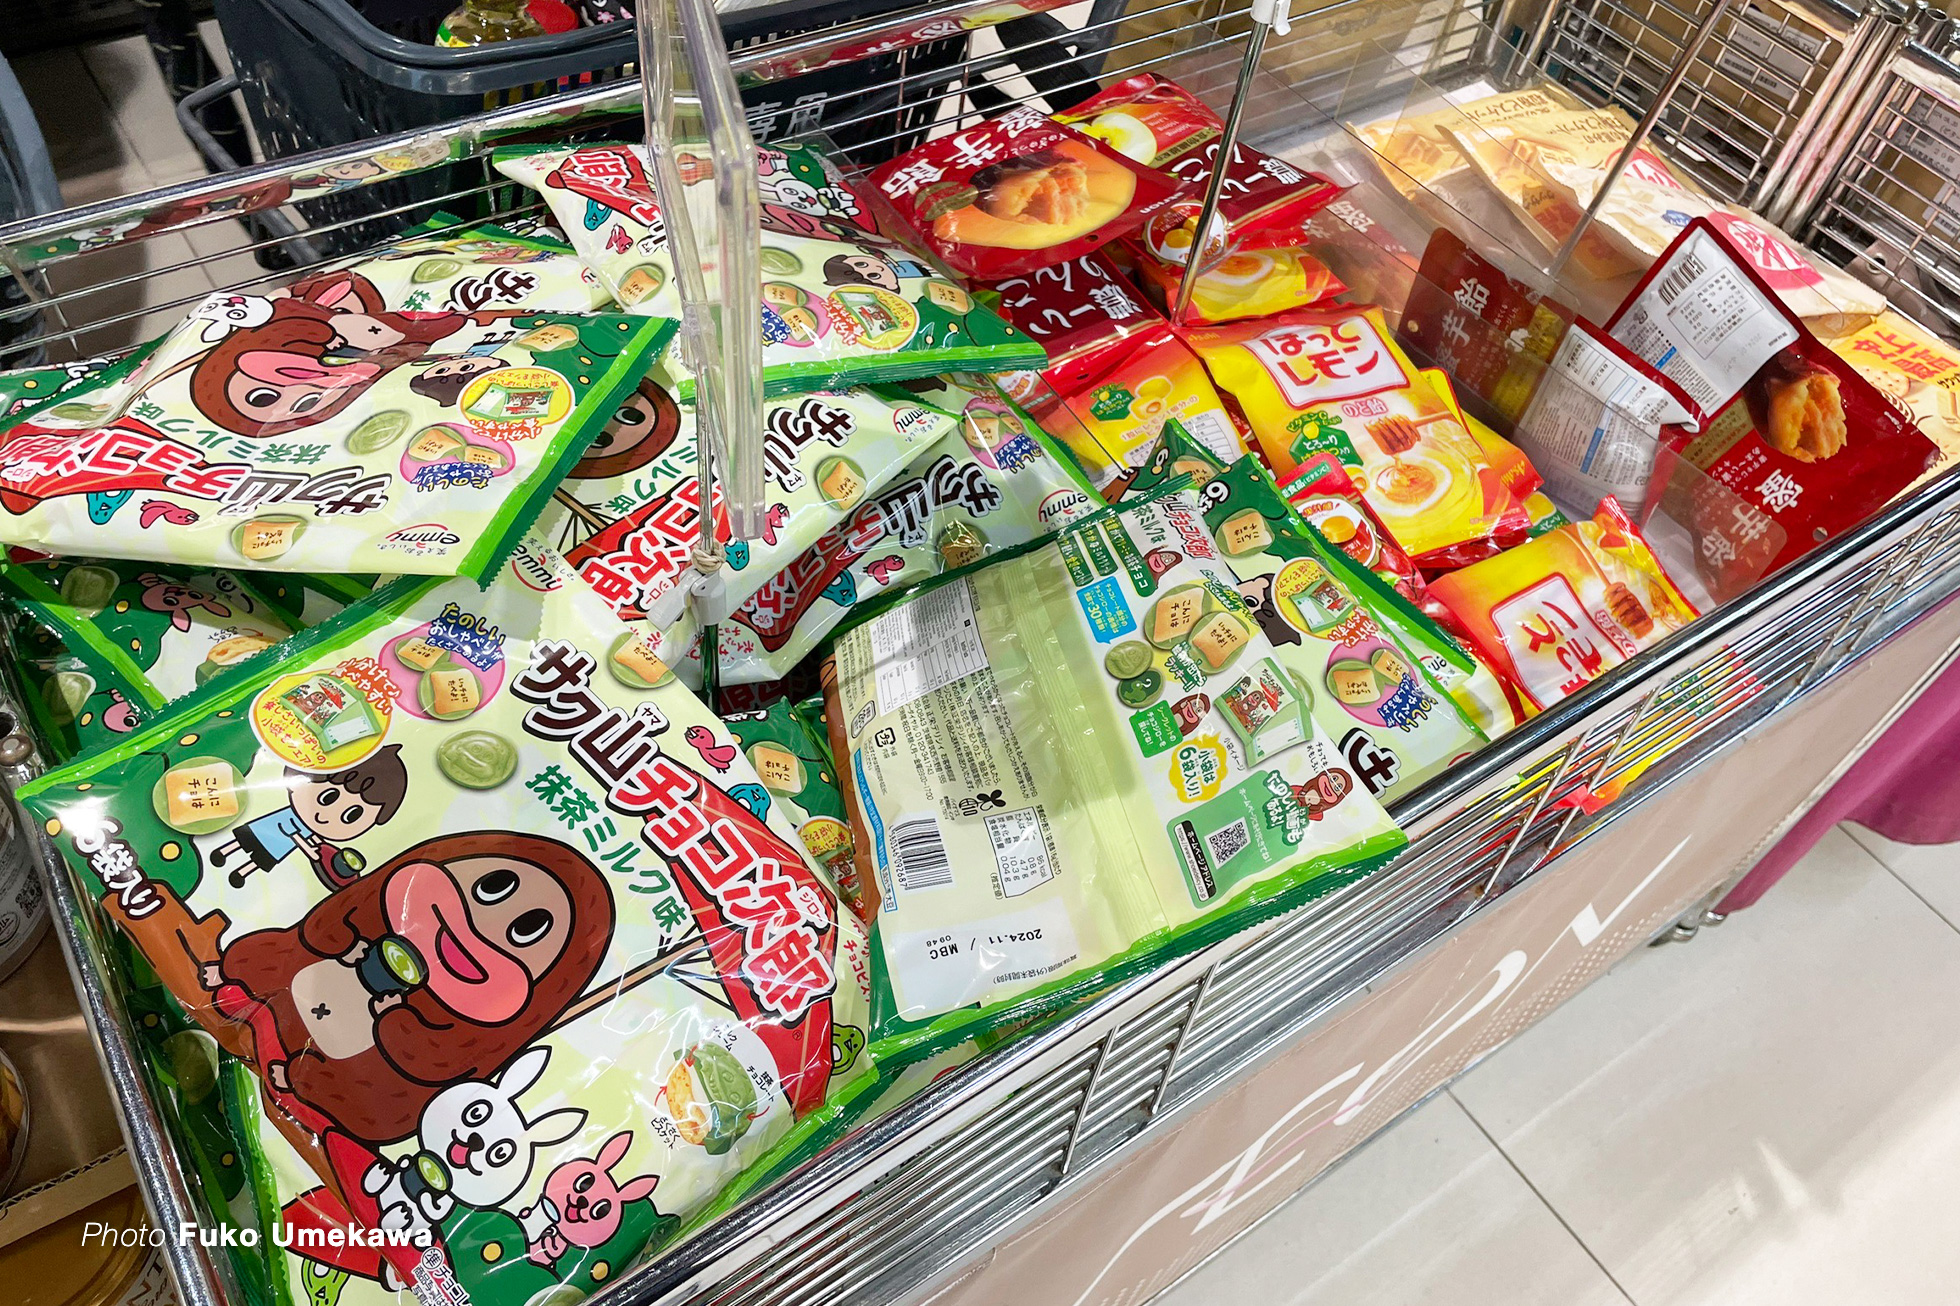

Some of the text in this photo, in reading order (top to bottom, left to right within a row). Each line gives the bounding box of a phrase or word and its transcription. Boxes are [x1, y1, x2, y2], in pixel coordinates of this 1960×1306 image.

[1259, 319, 1362, 361] ほっと
[1275, 341, 1381, 390] レモン
[1342, 396, 1388, 421] のど飴
[134, 402, 328, 464] 抹茶ミルク味
[385, 523, 459, 545] emmi
[1700, 464, 1807, 571] 蜜芋飴
[443, 602, 506, 645] たのしい
[1170, 602, 1178, 628] チョは
[1182, 598, 1192, 624] こんに
[429, 623, 504, 661] おしゃべりが
[1209, 628, 1227, 648] たべよ!
[1218, 621, 1238, 643] いっチョに
[262, 698, 327, 764] 楽しさいっぱいの
[640, 706, 659, 727] ヤマ
[1146, 711, 1166, 747] チョコジローを
[1156, 705, 1176, 741] シークレットの
[1177, 744, 1200, 797] 6袋入り!
[1196, 748, 1216, 785] 小袋は
[1222, 736, 1245, 772] 小袋イメージ
[204, 776, 220, 810] こんに
[516, 640, 836, 1022] サク山チョコ次郎
[524, 763, 688, 933] 抹茶ミルク味
[893, 858, 908, 888] 092687
[999, 855, 1010, 875] 0.04
[1008, 855, 1019, 874] 10.3
[799, 889, 825, 920] ジロー
[925, 934, 951, 946] 0948
[928, 943, 958, 959] MBC
[988, 927, 1042, 947] 2024.11
